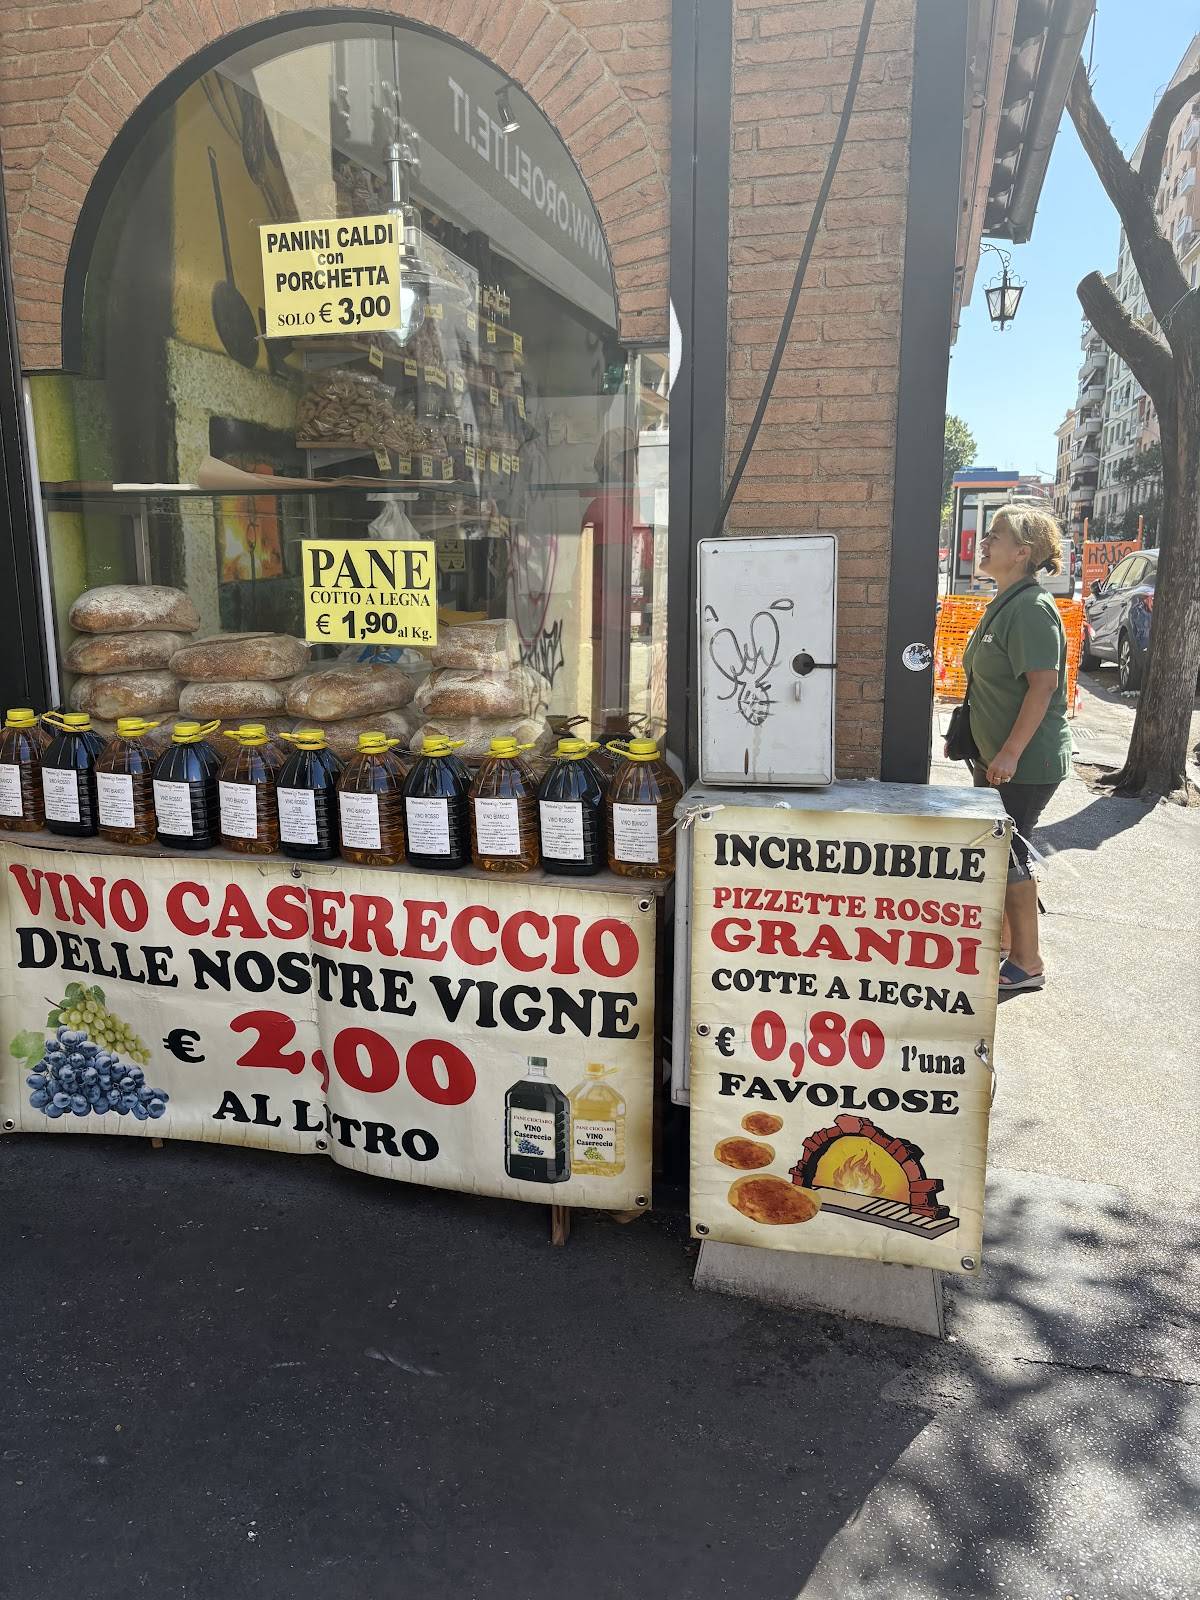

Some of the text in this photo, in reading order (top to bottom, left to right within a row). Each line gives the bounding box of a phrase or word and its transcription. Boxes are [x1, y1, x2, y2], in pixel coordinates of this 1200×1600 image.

[267, 224, 393, 253] PANINI CALDI
[317, 252, 344, 266] con
[276, 265, 390, 293] PORCHETTA
[277, 295, 391, 326] SOLO € 3,00
[308, 549, 431, 590] PANE
[310, 591, 430, 607] COTTO A LEGNA
[316, 610, 432, 641] € 1,90 al Kg.
[713, 833, 986, 883] INCREDIBILE
[9, 864, 640, 978] VINO CASERECCIO
[712, 887, 982, 929] PIZZETTE ROSSE
[710, 917, 982, 975] GRANDI
[16, 927, 640, 1040] DELLE NOSTRE VIGNE
[711, 968, 975, 1015] COTTE A LEGNA
[163, 1010, 477, 1106] € 2,00
[714, 1026, 735, 1057] €
[750, 1009, 885, 1078] 0,80
[212, 1090, 281, 1128] AL
[718, 1072, 959, 1114] FAVOLOSE
[514, 1130, 552, 1141] Casereccio
[524, 1124, 542, 1133] VINO
[576, 1139, 613, 1147] Casereccio
